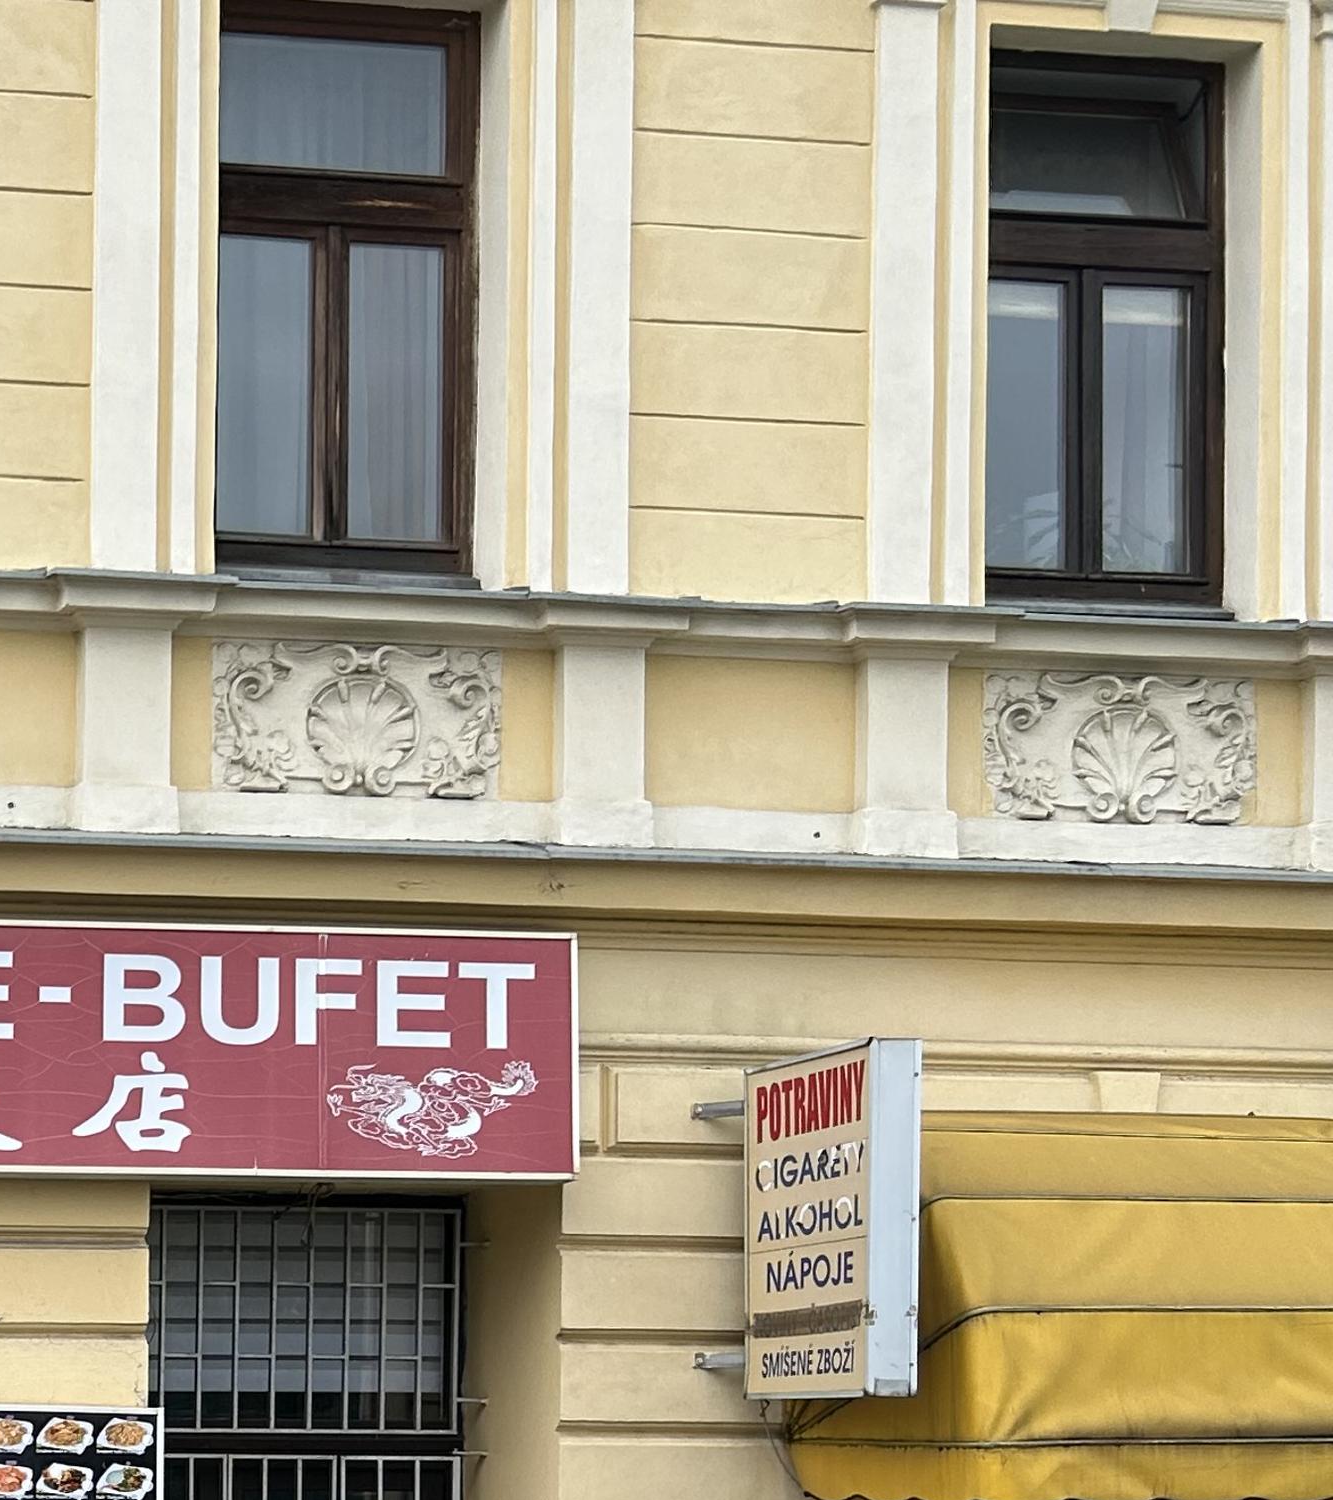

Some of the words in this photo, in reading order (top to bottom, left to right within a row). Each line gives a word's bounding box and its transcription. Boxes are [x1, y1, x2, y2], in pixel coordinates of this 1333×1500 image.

[102, 952, 535, 1050] BUFET
[756, 1060, 865, 1144] POTRAVINY
[757, 1194, 862, 1242] ALKOHOL
[766, 1250, 854, 1293] NÁPOJE
[762, 1344, 813, 1378] SMÍŠENÉ
[817, 1338, 855, 1374] ZBOŽÍ
